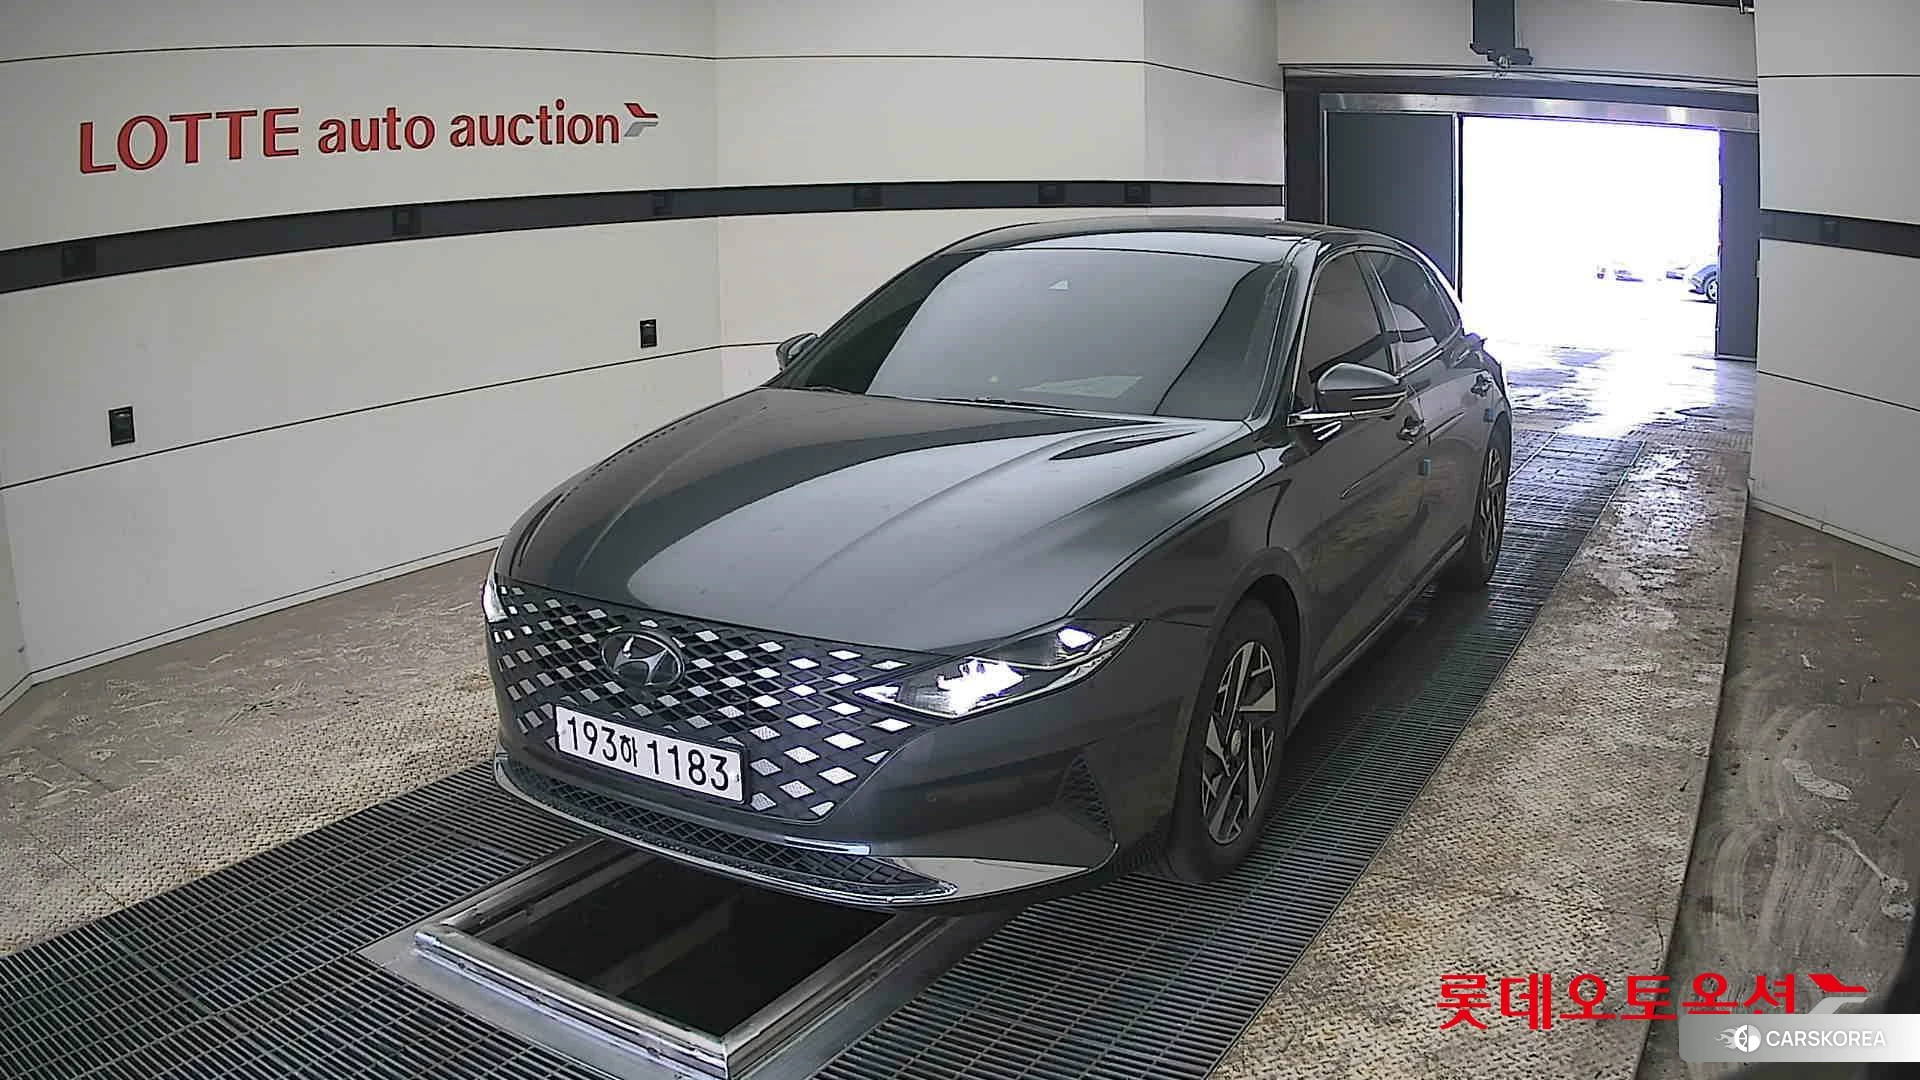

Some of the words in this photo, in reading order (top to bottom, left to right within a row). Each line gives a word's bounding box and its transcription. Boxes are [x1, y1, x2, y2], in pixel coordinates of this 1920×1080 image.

[79, 107, 299, 174] LOTTE
[318, 106, 436, 154] auto
[449, 98, 620, 147] auction
[567, 715, 638, 768] 193하
[647, 740, 729, 791] 1183
